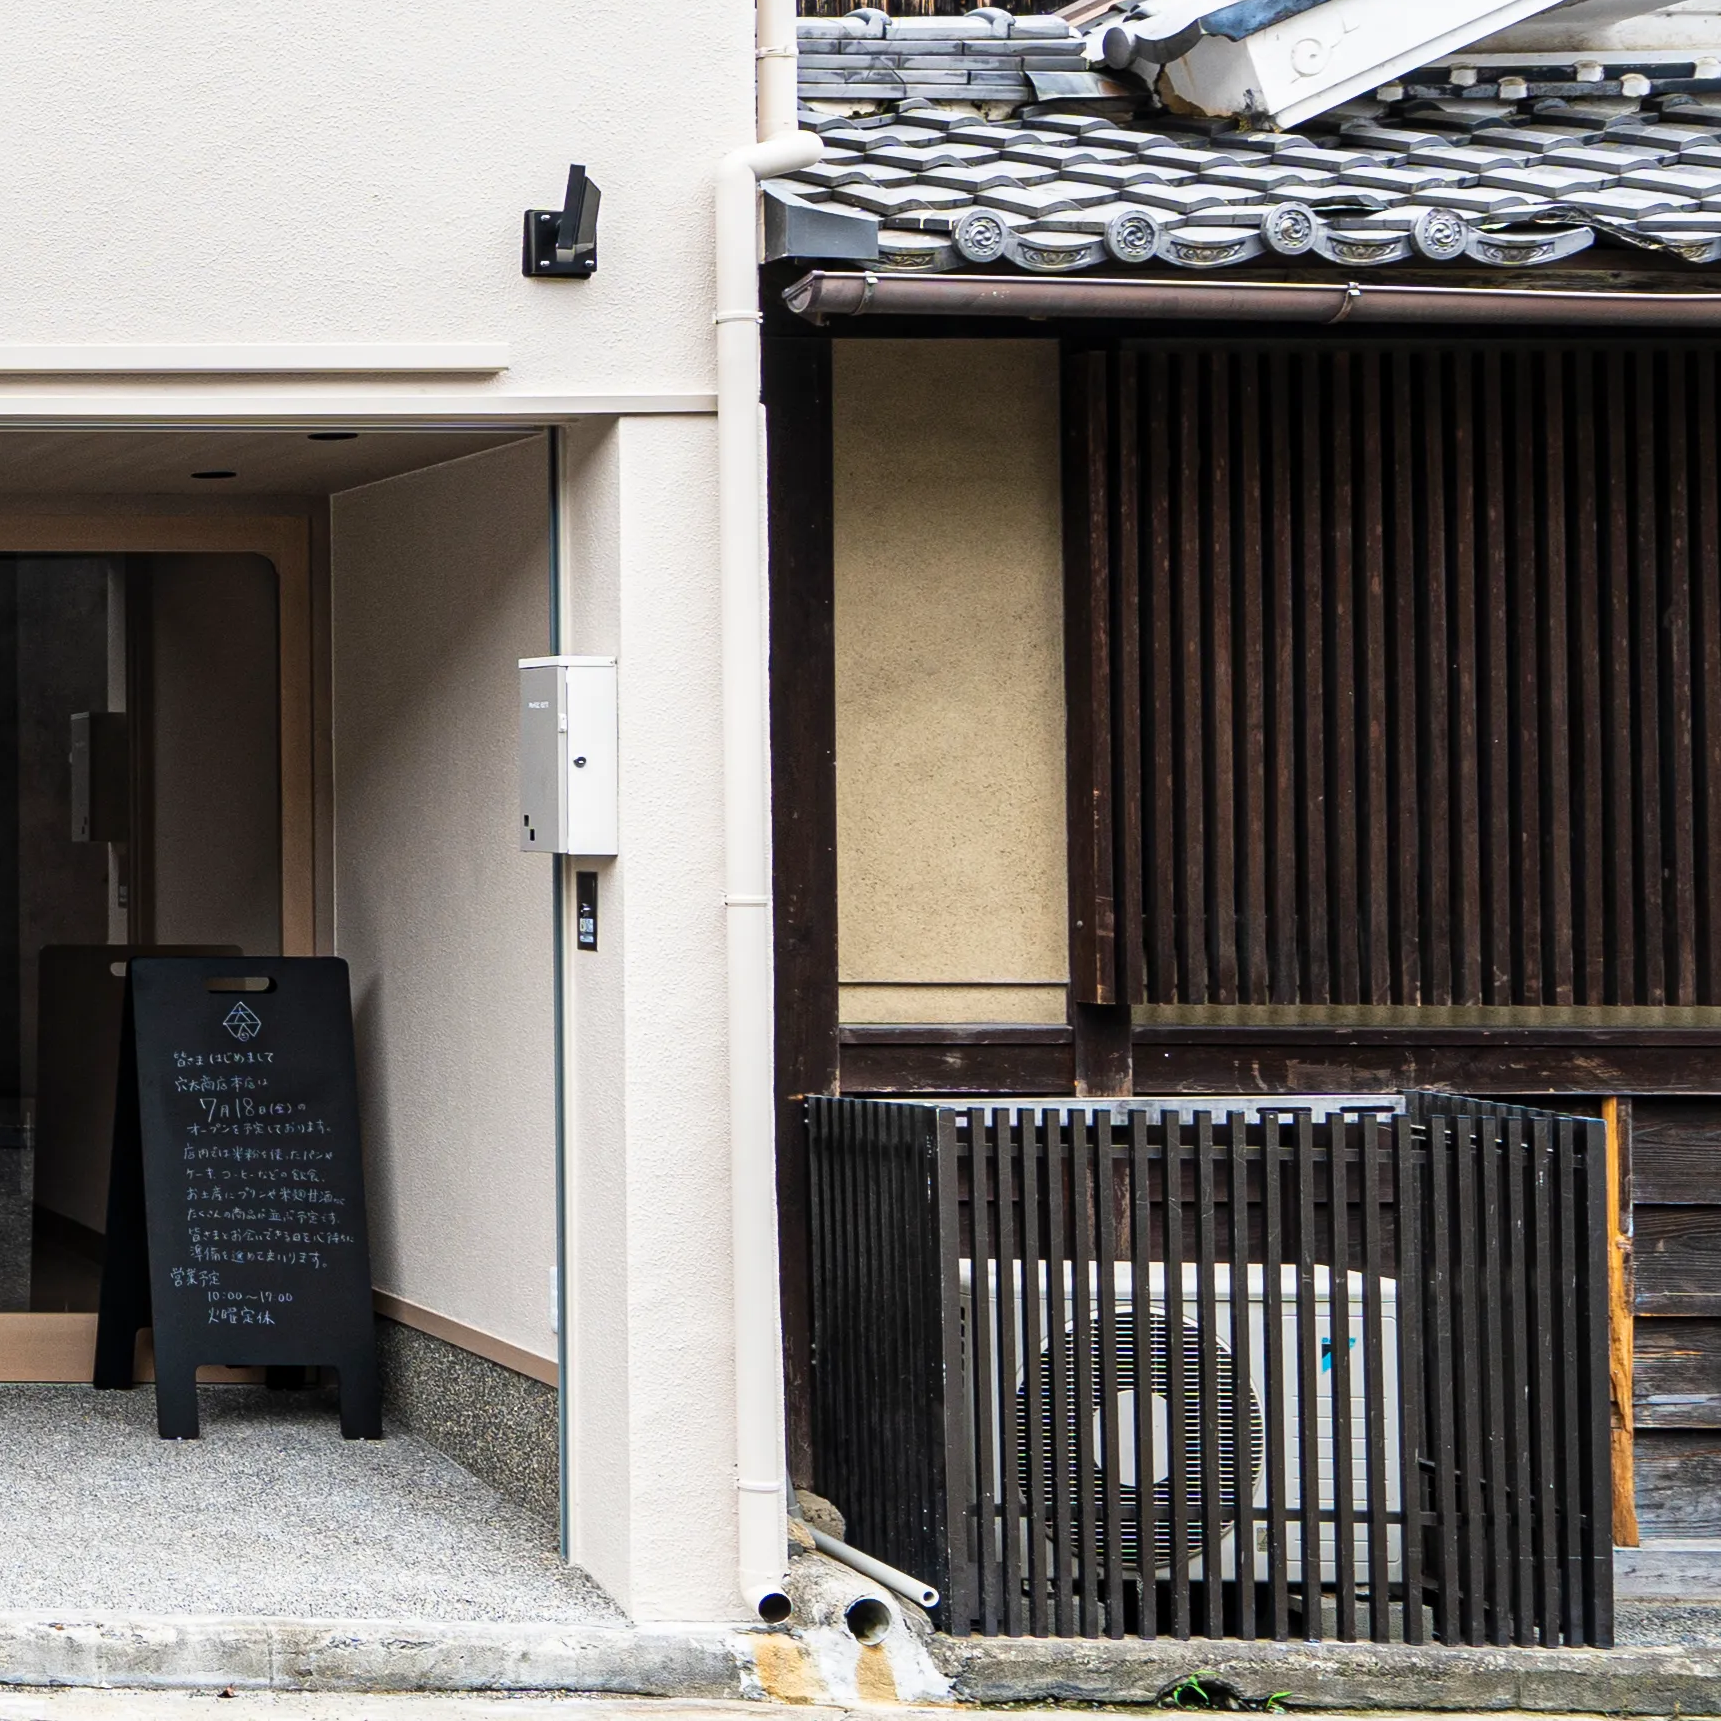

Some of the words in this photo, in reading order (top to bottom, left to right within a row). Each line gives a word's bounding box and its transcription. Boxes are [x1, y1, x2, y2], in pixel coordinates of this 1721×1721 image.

[175, 1075, 267, 1092] 穴太商店本店は
[170, 1267, 220, 1287] 営業予定
[209, 1306, 275, 1324] 火曜定休
